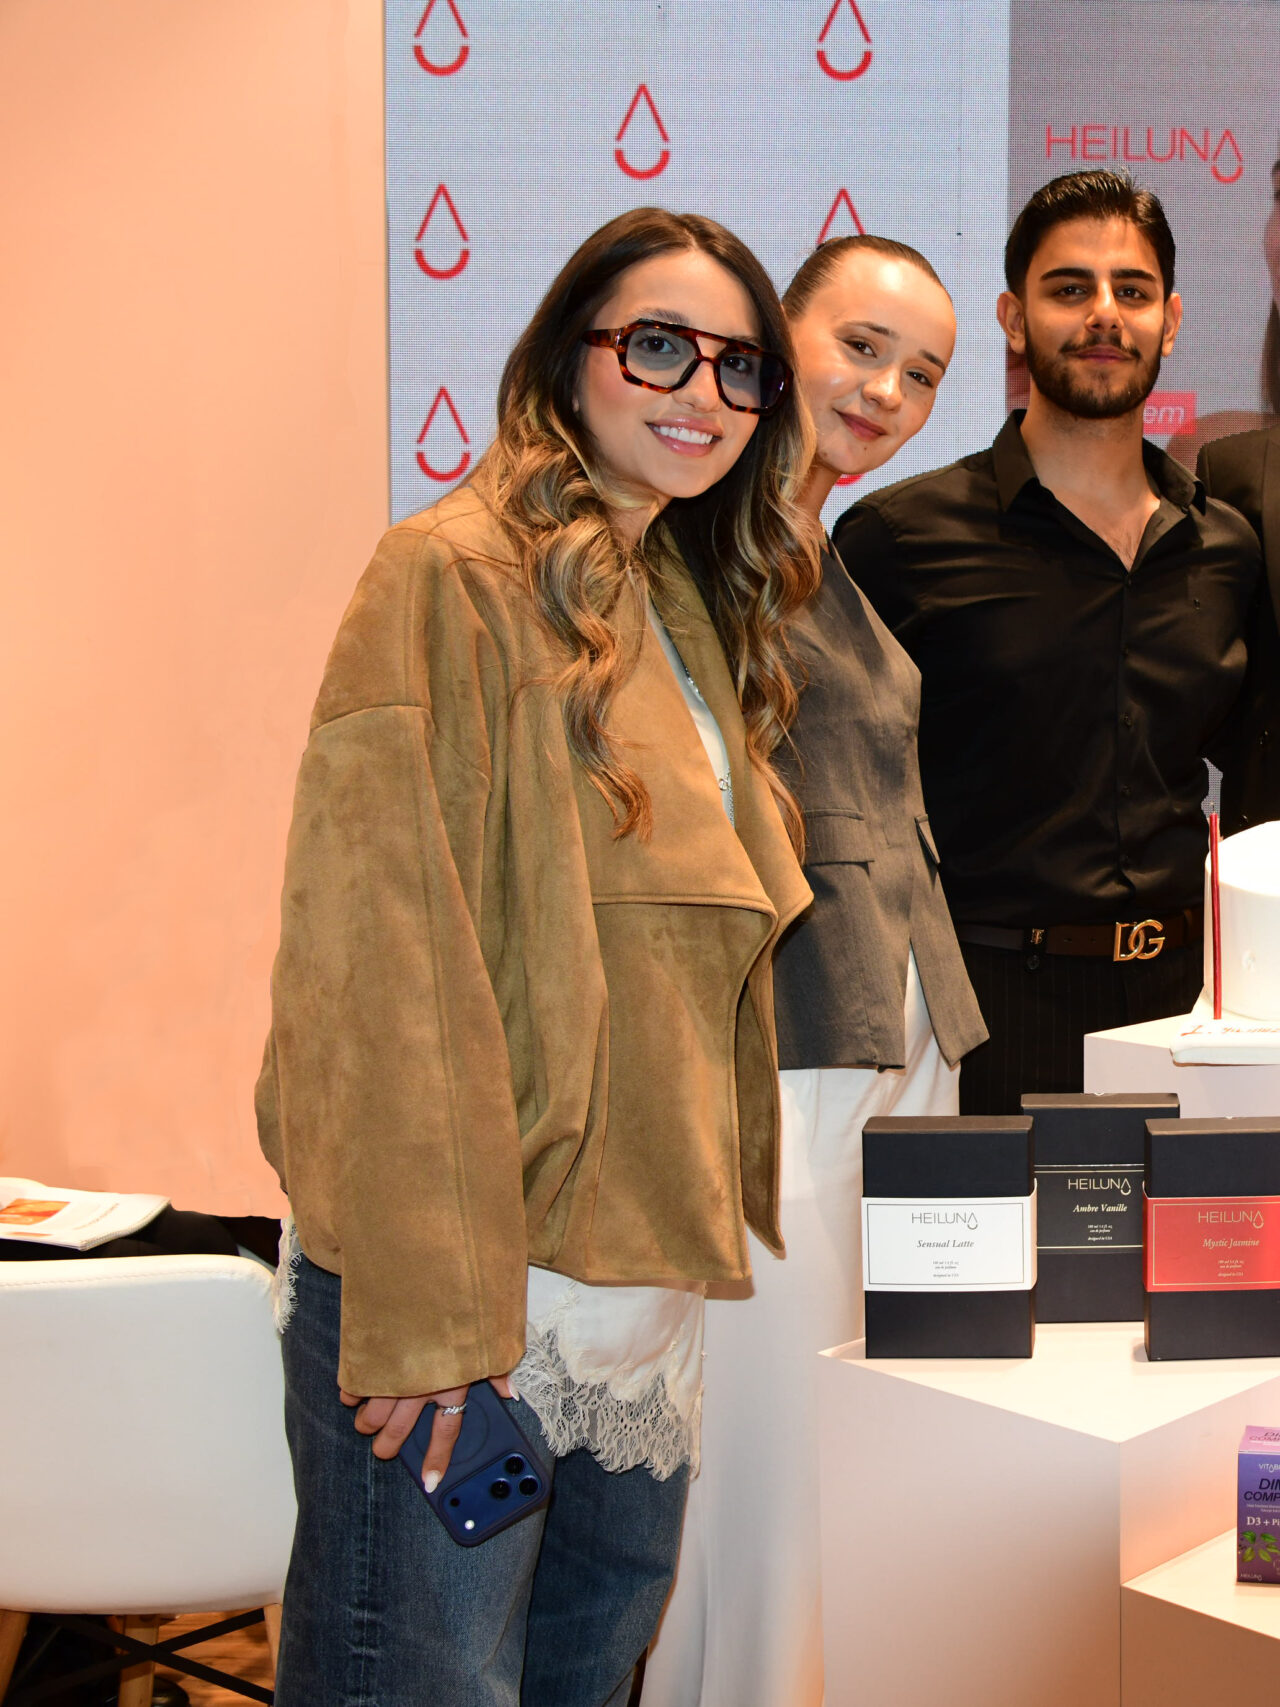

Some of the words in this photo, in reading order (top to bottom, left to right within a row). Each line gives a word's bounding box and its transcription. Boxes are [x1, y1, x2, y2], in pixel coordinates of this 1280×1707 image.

[1046, 124, 1244, 184] HEILUNA
[1113, 919, 1165, 962] DG
[1067, 1178, 1132, 1196] HEILUNA
[1073, 1204, 1099, 1213] Ambre
[1101, 1203, 1127, 1212] Vanille
[911, 1212, 978, 1230] HEILUNA
[1198, 1210, 1264, 1229] HEILUNA
[917, 1240, 950, 1248] Sensual
[952, 1240, 975, 1248] Latte
[1203, 1239, 1228, 1249] Mystic
[1228, 1238, 1260, 1249] Jasmine
[1246, 1516, 1261, 1526] D3
